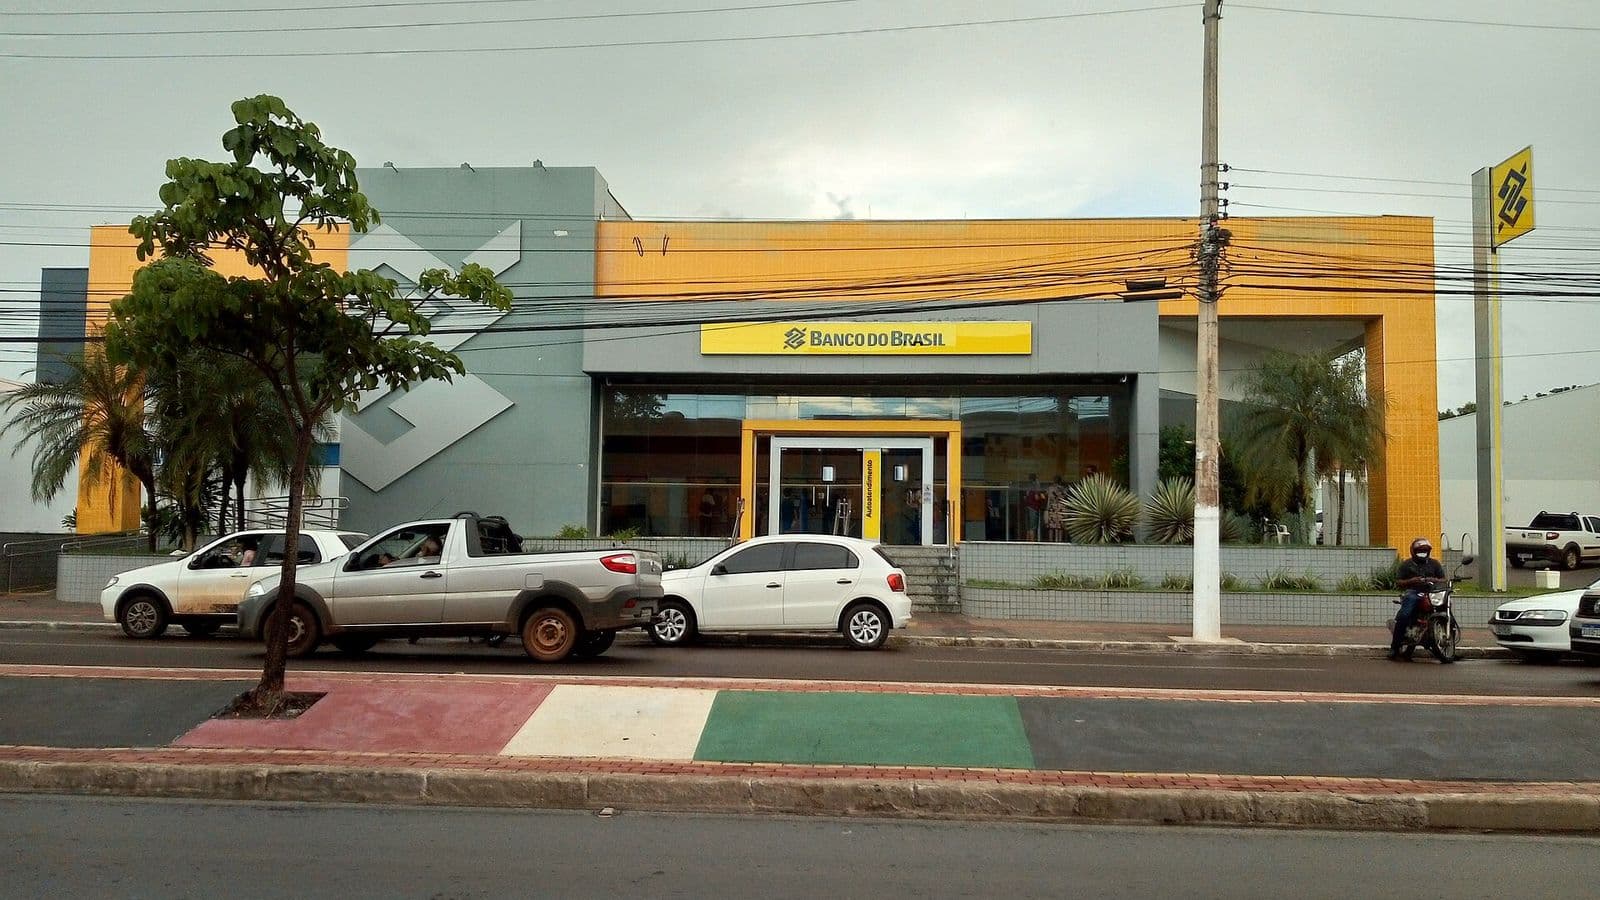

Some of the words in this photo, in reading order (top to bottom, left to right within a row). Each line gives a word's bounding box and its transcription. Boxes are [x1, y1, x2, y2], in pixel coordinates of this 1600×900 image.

[810, 330, 865, 347] BANCO
[867, 332, 889, 347] DO
[891, 330, 946, 347] BRASIL
[865, 459, 873, 518] Autoatendimento
